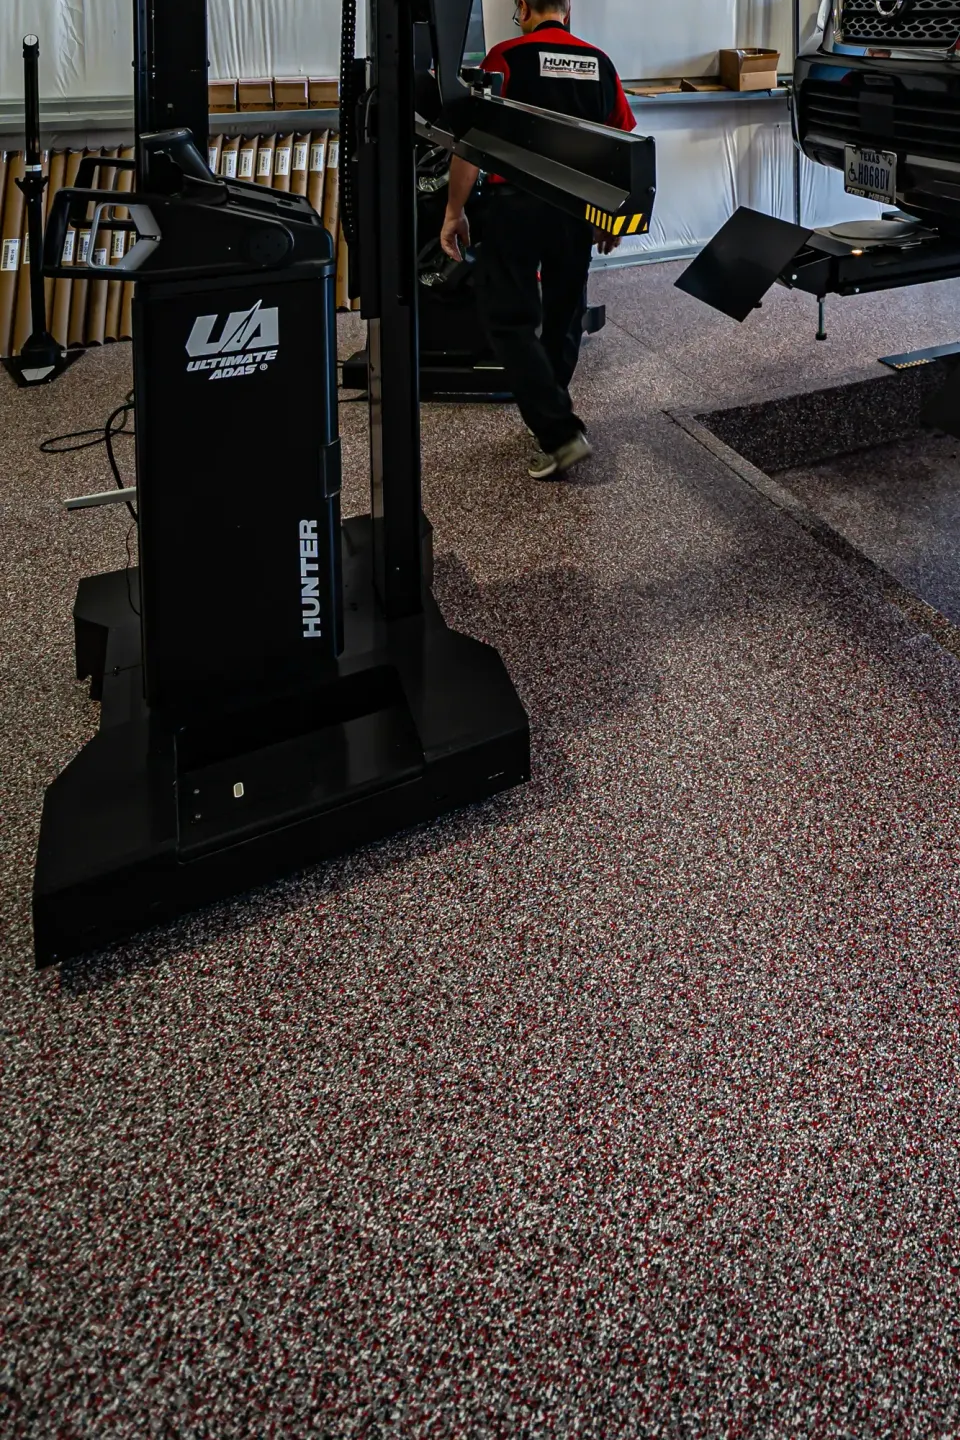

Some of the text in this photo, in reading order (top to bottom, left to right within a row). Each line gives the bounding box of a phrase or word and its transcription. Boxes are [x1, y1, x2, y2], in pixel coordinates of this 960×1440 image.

[543, 56, 597, 70] HUNTER
[860, 151, 880, 165] TEXAS
[186, 349, 279, 372] ULTIMATE
[299, 519, 322, 638] HUNTER
